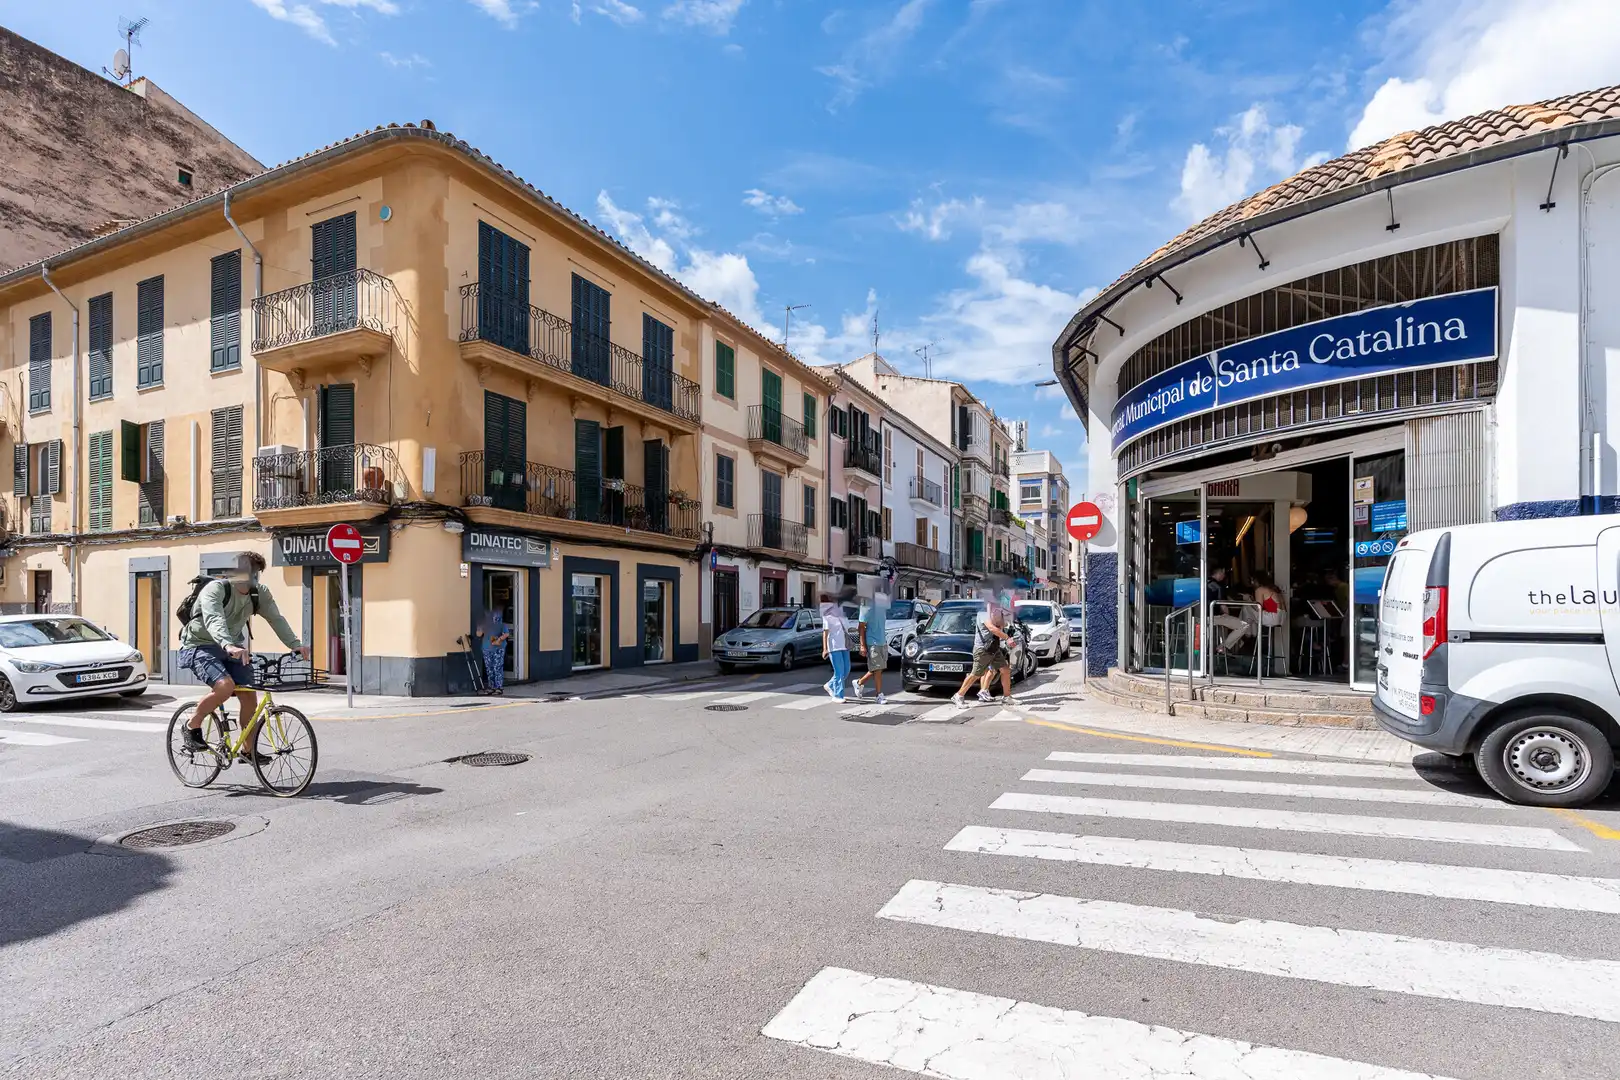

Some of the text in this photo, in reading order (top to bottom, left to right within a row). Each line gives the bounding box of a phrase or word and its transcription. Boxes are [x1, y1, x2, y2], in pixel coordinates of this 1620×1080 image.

[1126, 377, 1184, 425] Municipal
[1189, 371, 1213, 397] de
[1218, 349, 1301, 388] Santa
[1309, 316, 1468, 364] Catalina
[470, 532, 522, 550] DINATEC
